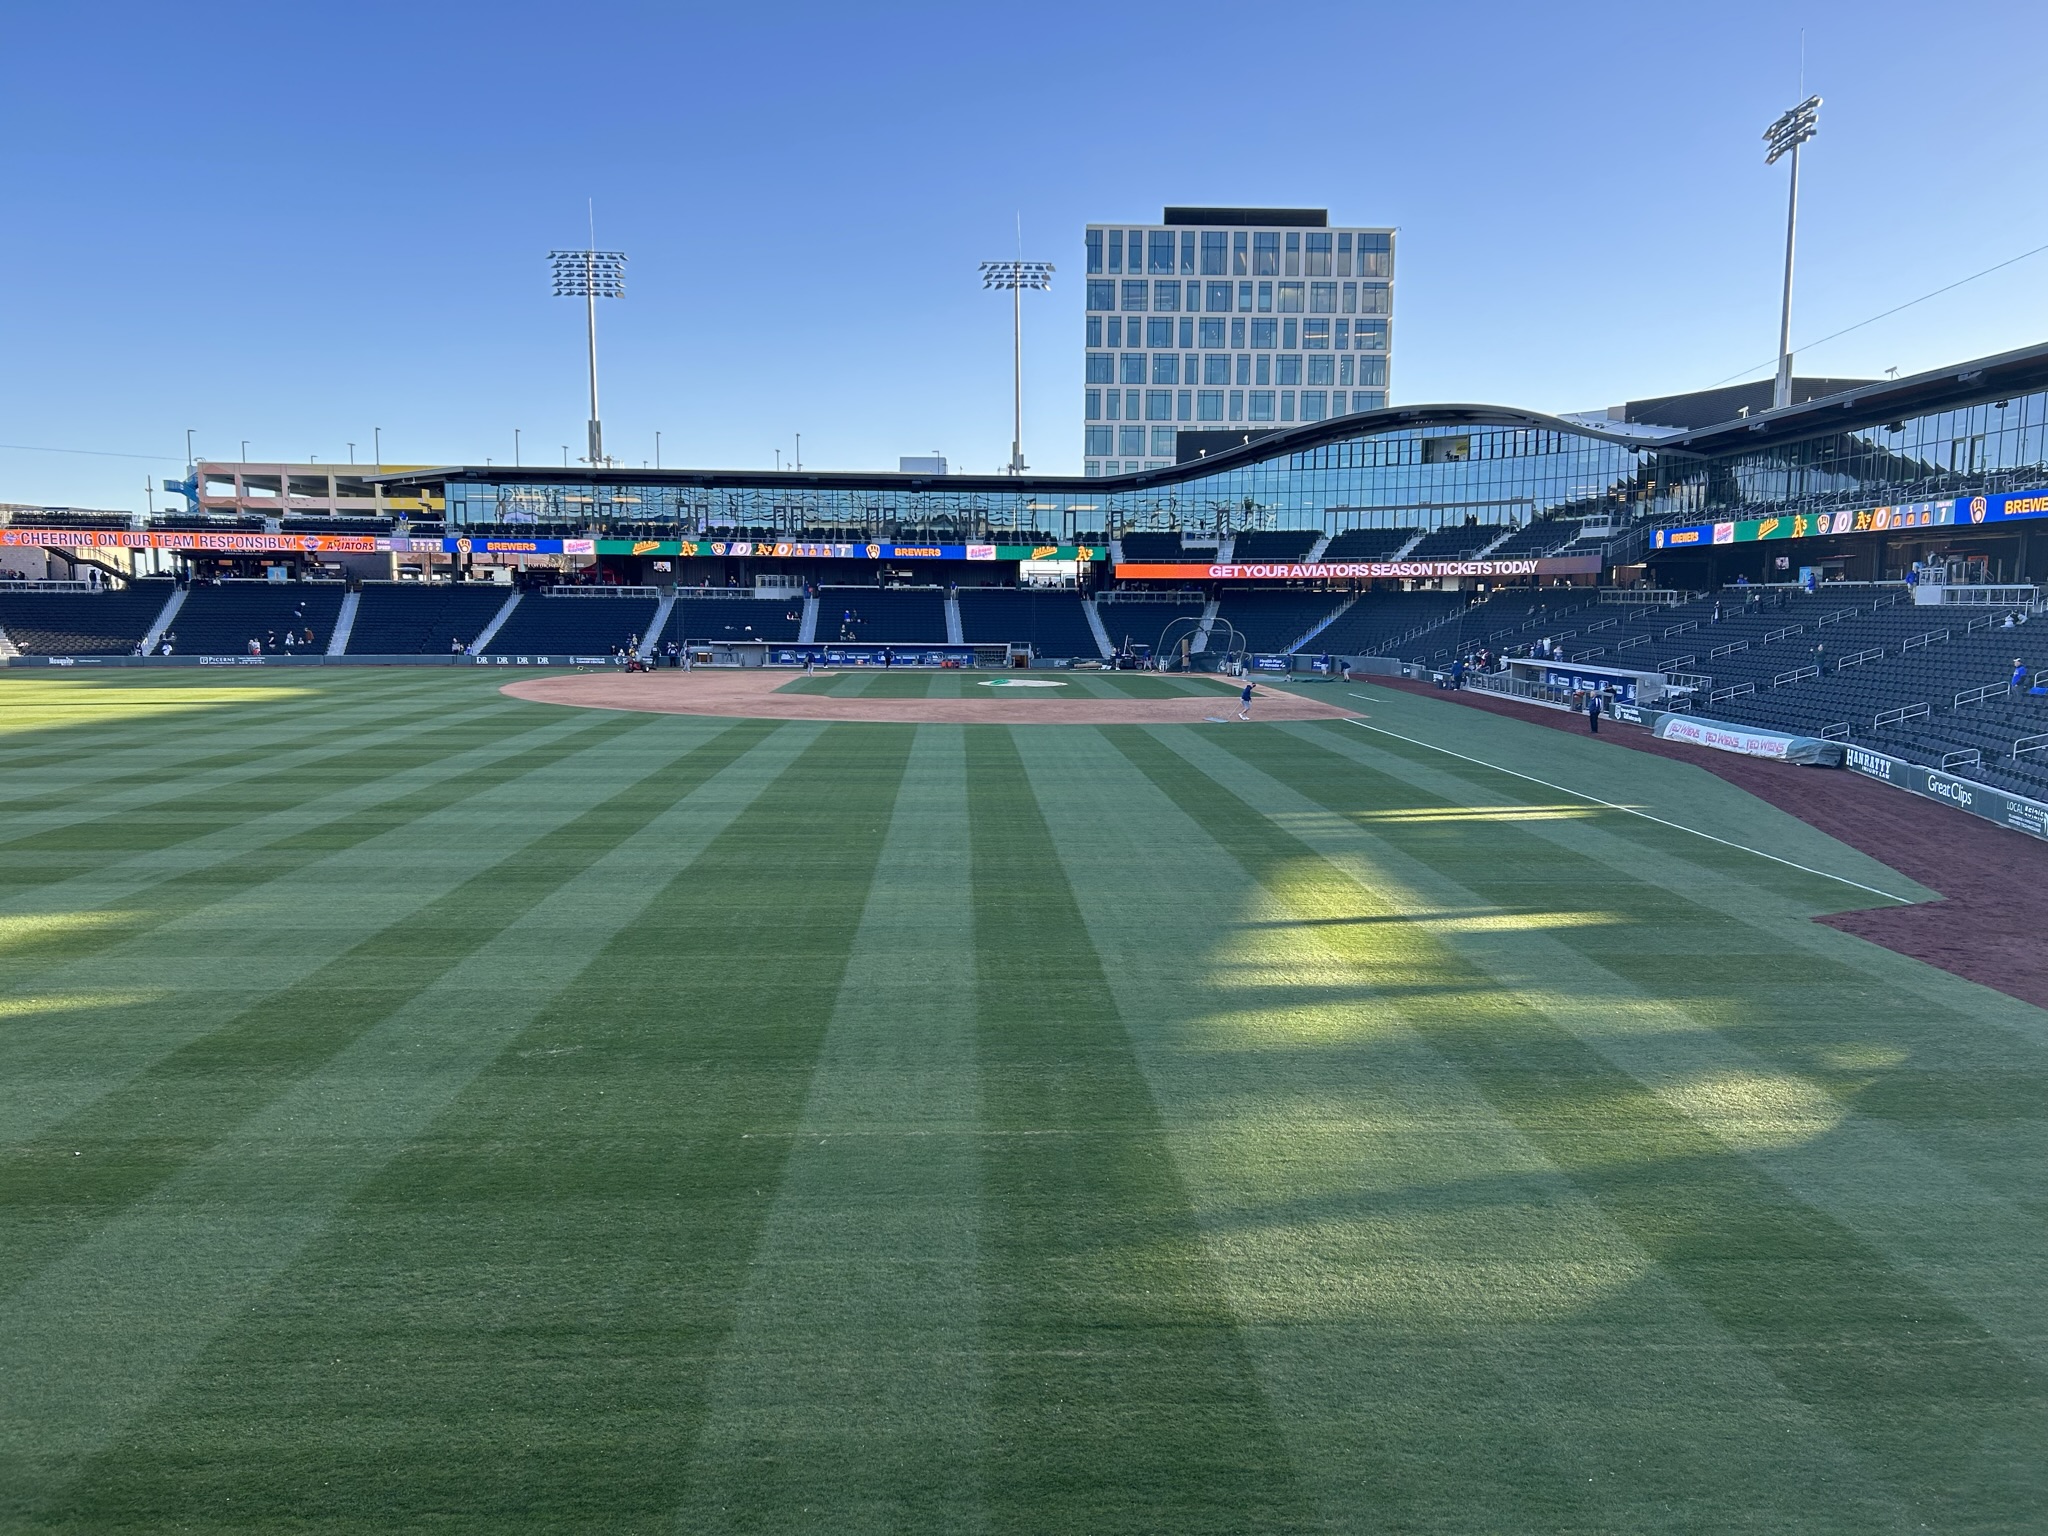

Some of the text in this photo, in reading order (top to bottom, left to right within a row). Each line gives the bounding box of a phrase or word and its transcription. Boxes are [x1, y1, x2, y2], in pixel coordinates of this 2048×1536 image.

[1838, 513, 1848, 531] 0
[1854, 511, 1871, 530] A's
[1876, 509, 1886, 528] 0
[1940, 507, 1947, 523] 1
[1791, 514, 1808, 540] A's
[21, 532, 297, 549] CHEERING ON OUR TEAM RESPONSIBLY!
[1670, 531, 1699, 544] BREWERS
[486, 541, 537, 551] BREWERS
[679, 540, 698, 557] A's
[737, 544, 747, 554] 0
[755, 542, 773, 556] A's
[779, 543, 788, 554] 0
[894, 547, 942, 557] BREWERS
[1076, 545, 1094, 561] A's
[1209, 560, 1538, 577] GET YOUR AVIATORS SEASON TICKETS TODAY
[1669, 723, 1681, 733] TED
[1705, 732, 1717, 743] TED
[1746, 738, 1760, 750] TED
[1846, 748, 1891, 773] HANRATTY
[1861, 765, 1890, 780] INJURY LAW
[1928, 774, 1973, 808] Great Clips
[2006, 800, 2024, 815] LOCAL
